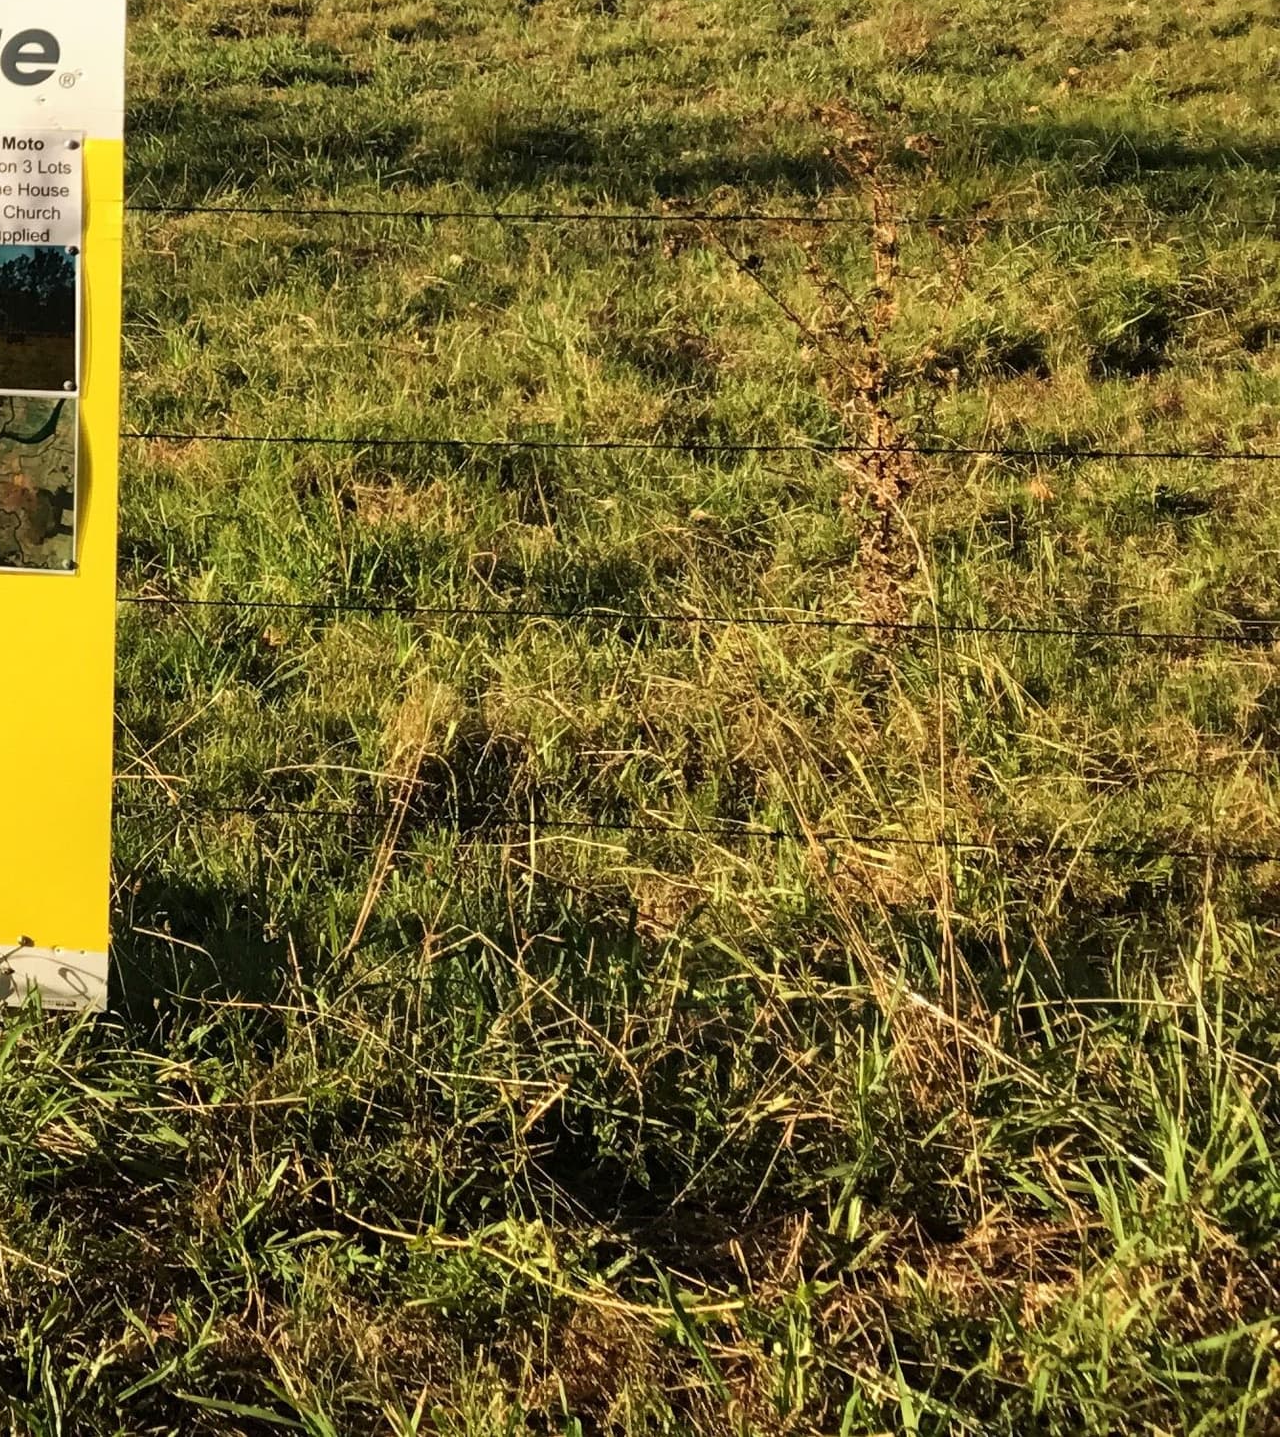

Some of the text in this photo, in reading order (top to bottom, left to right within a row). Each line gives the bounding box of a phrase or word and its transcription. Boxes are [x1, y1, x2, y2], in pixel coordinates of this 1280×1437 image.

[1, 136, 44, 152] Moto
[23, 159, 33, 174] 3
[38, 159, 72, 175] Lots
[18, 183, 70, 198] House
[3, 205, 61, 220] Church
